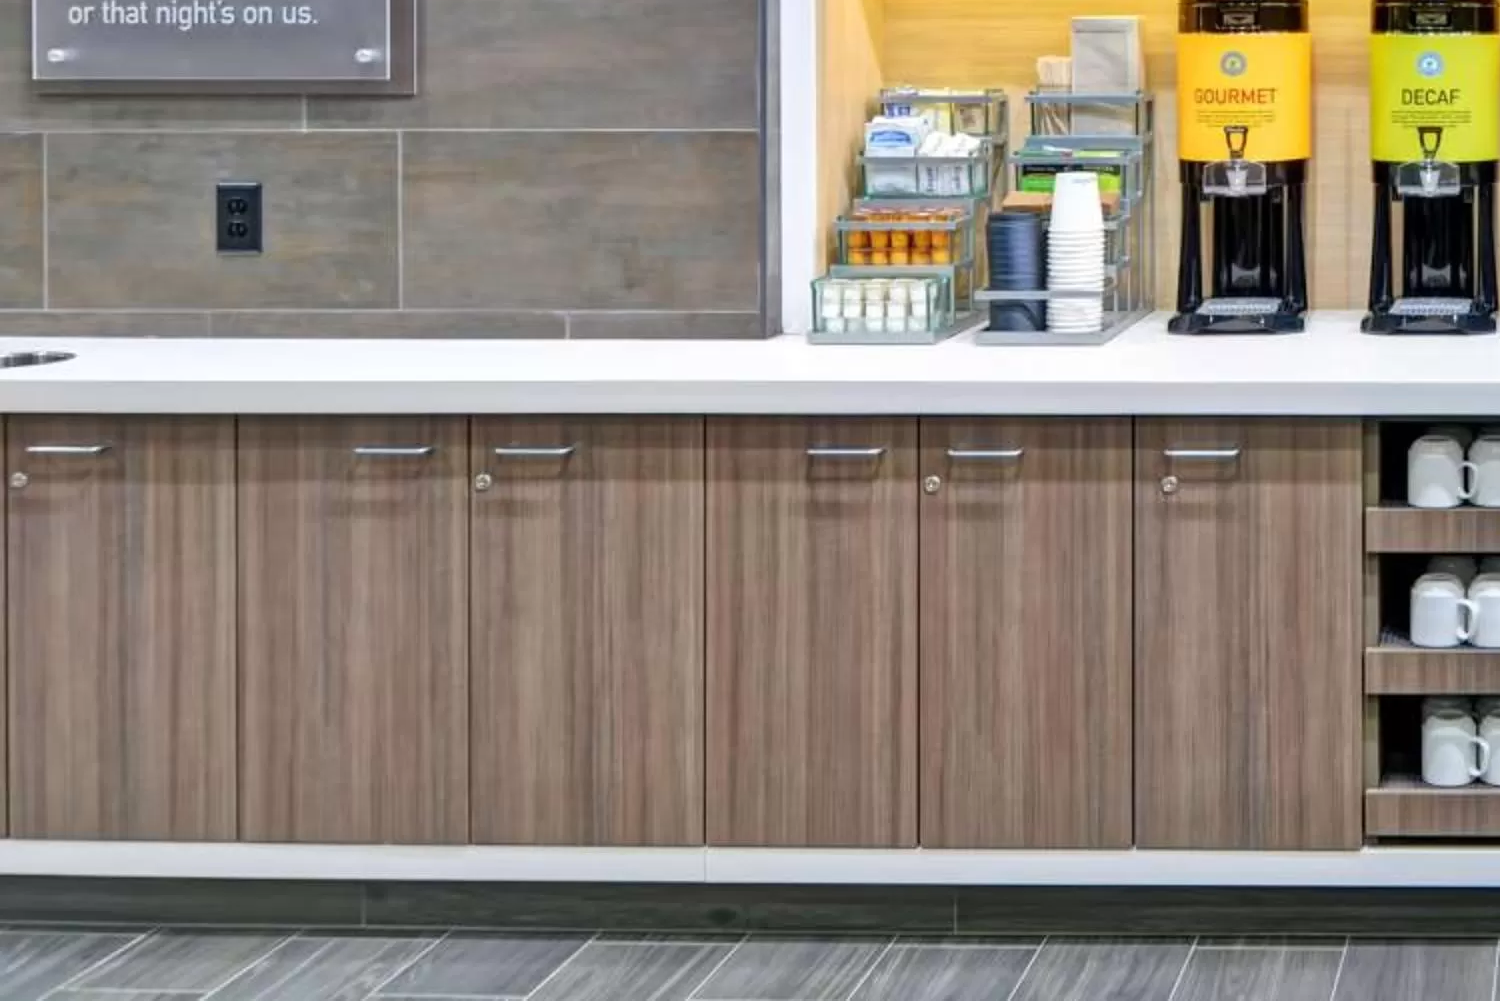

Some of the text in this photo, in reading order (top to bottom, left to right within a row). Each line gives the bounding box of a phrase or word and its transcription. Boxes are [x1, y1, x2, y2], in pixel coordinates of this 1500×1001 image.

[68, 0, 319, 31] or that night's on us.
[1194, 87, 1278, 104] GOURMET
[1401, 88, 1461, 106] DECAF
